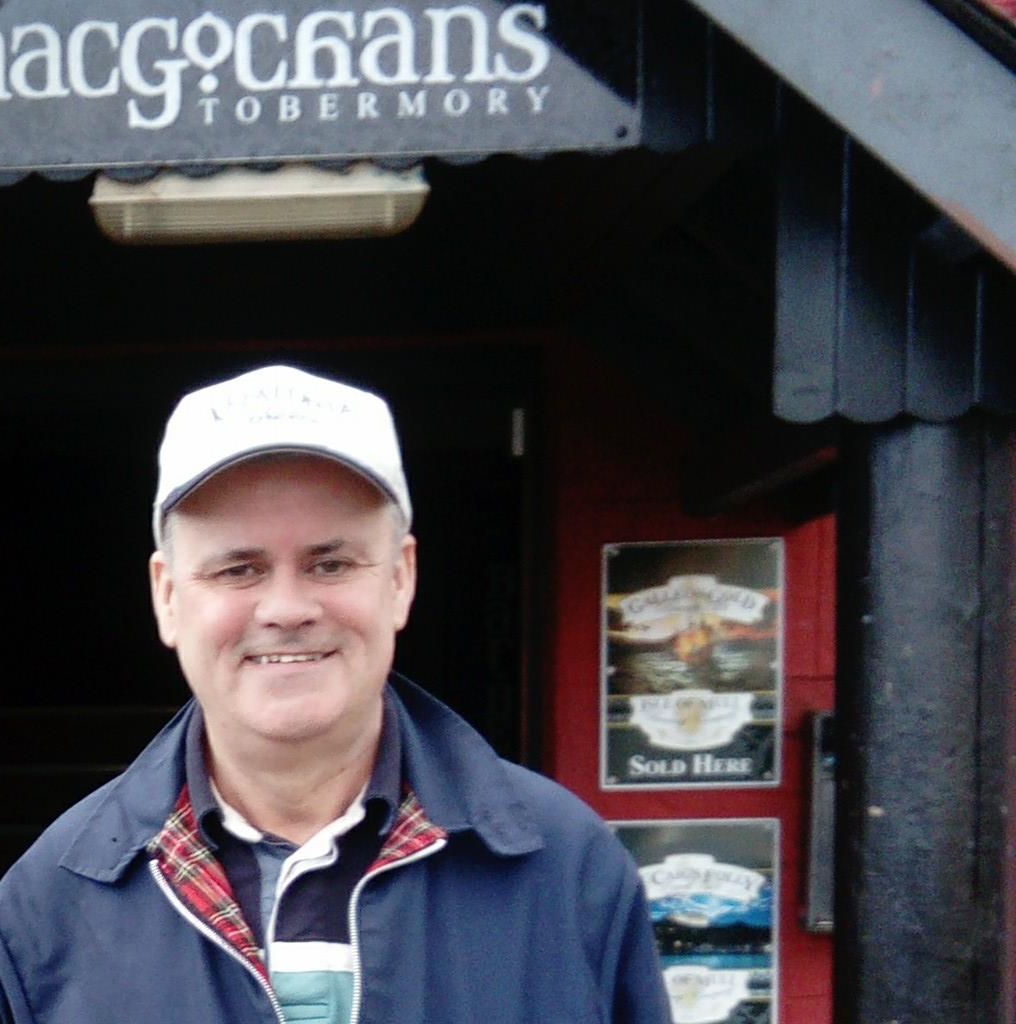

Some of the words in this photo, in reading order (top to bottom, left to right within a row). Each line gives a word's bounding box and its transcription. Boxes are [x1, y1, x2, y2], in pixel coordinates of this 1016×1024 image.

[197, 86, 550, 126] TOBERMORY
[629, 754, 686, 776] SOLD
[692, 752, 753, 775] HERE
